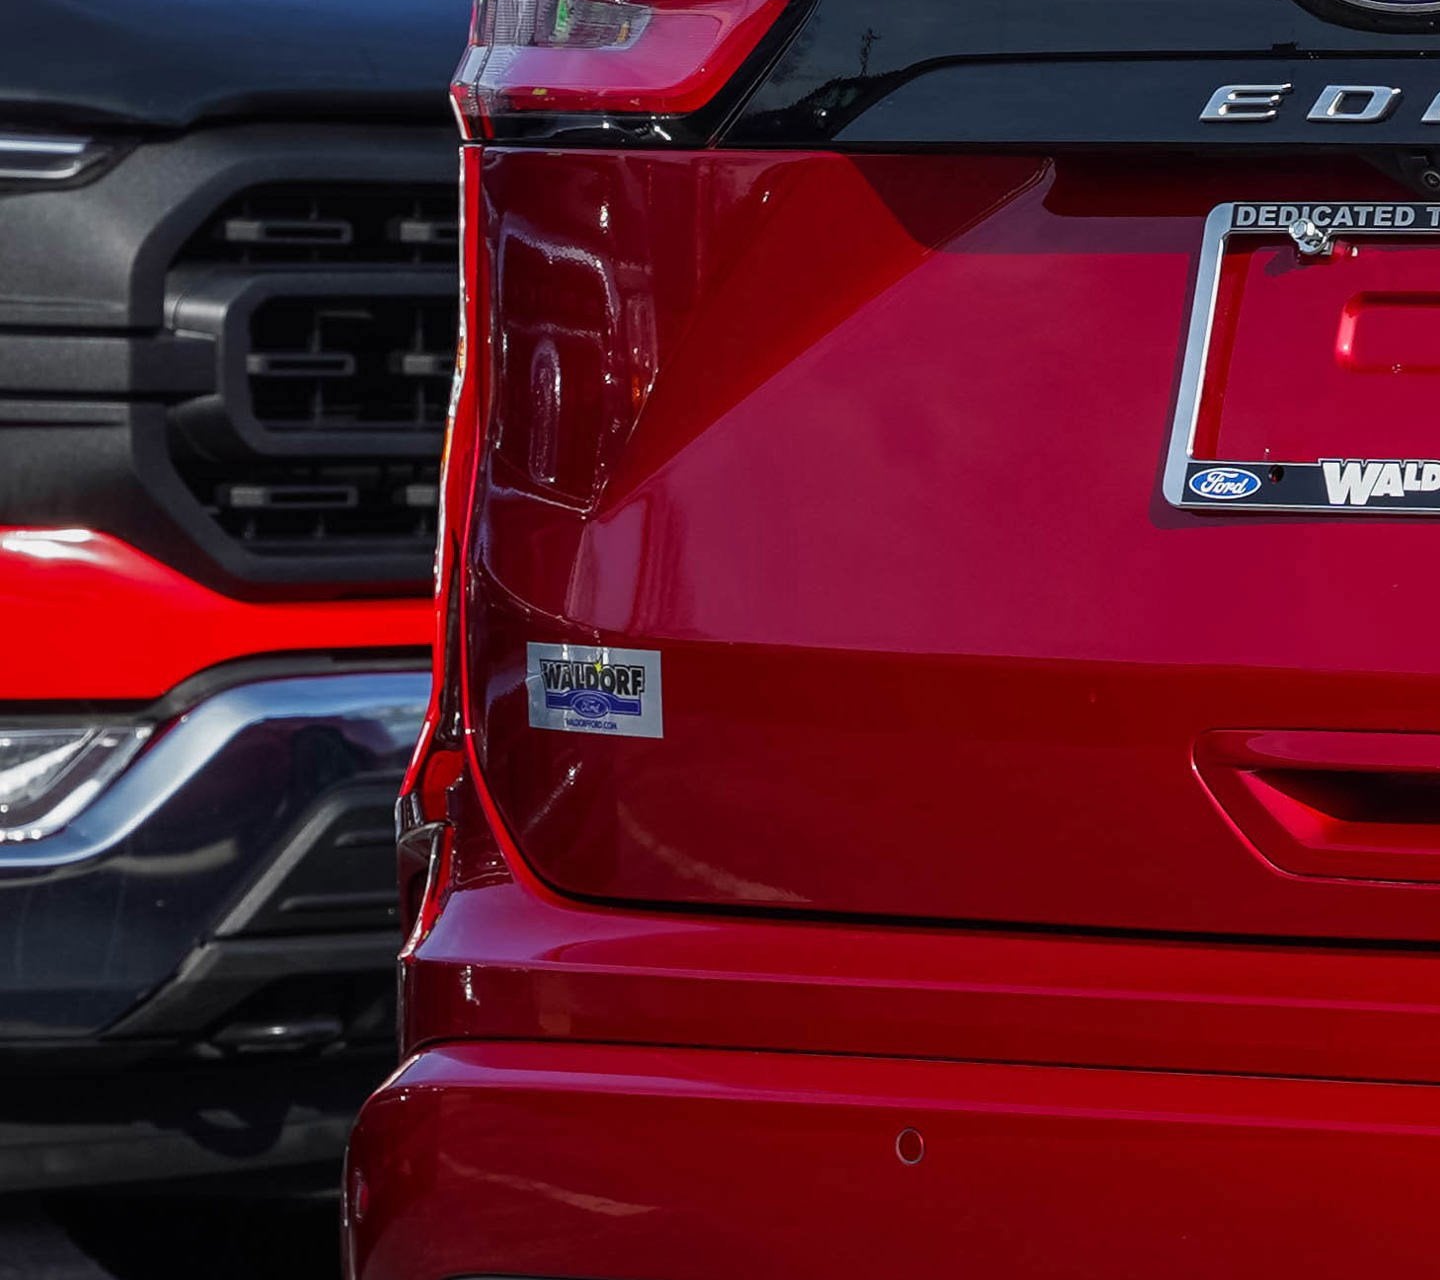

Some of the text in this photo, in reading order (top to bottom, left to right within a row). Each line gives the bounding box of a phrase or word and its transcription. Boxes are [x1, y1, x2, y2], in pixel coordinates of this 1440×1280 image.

[1236, 205, 1416, 228] DEDICATED
[1199, 468, 1250, 497] Ford
[539, 659, 645, 696] WALDORF
